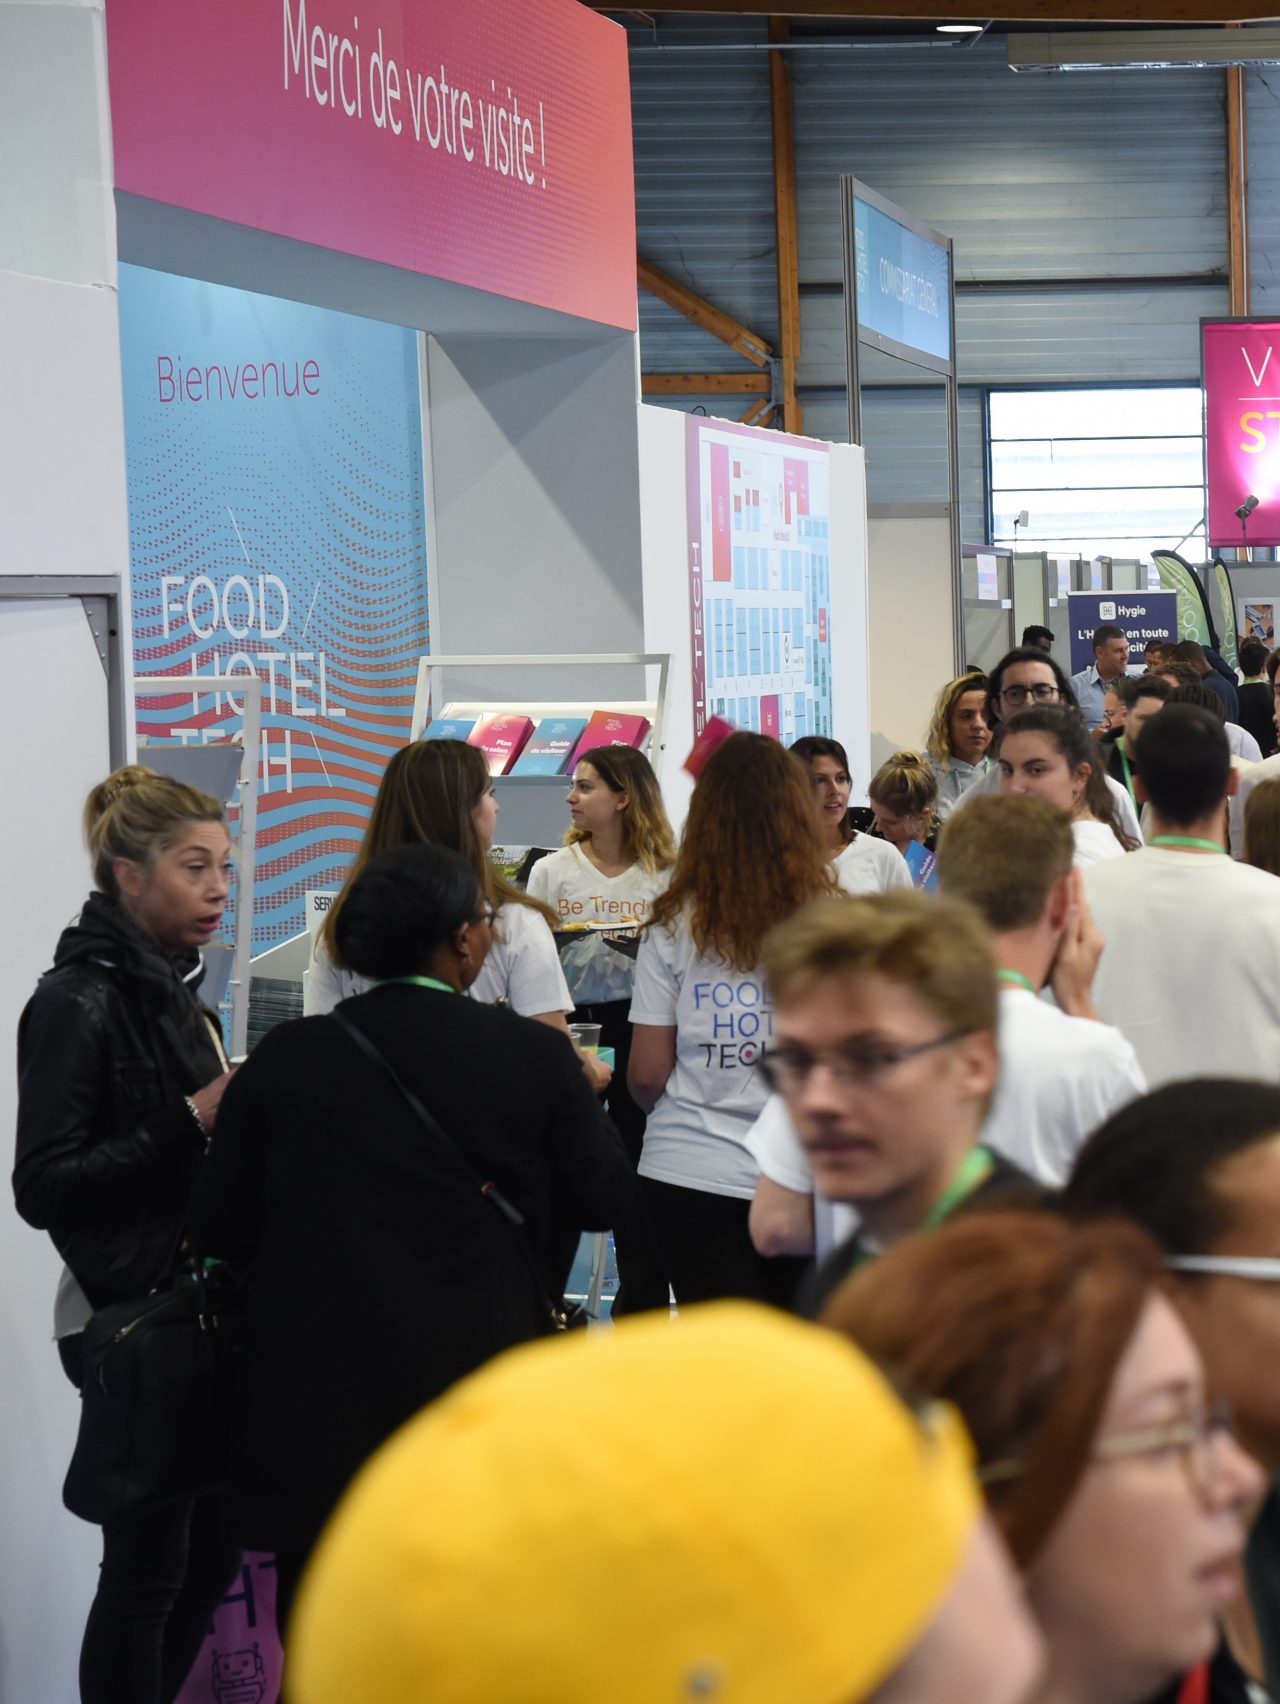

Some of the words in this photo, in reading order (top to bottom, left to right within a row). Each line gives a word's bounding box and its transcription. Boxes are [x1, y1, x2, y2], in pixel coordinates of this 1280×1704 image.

[283, 0, 362, 119] Merci
[369, 27, 402, 136] de
[406, 64, 474, 162] votre
[479, 79, 535, 186] visite
[157, 355, 321, 403] Bienvenue
[161, 574, 290, 640] FOOD
[1117, 605, 1146, 618] Hygie
[1126, 630, 1140, 639] en
[1141, 628, 1169, 638] toute
[496, 739, 513, 747] Plan
[558, 898, 584, 916] Be
